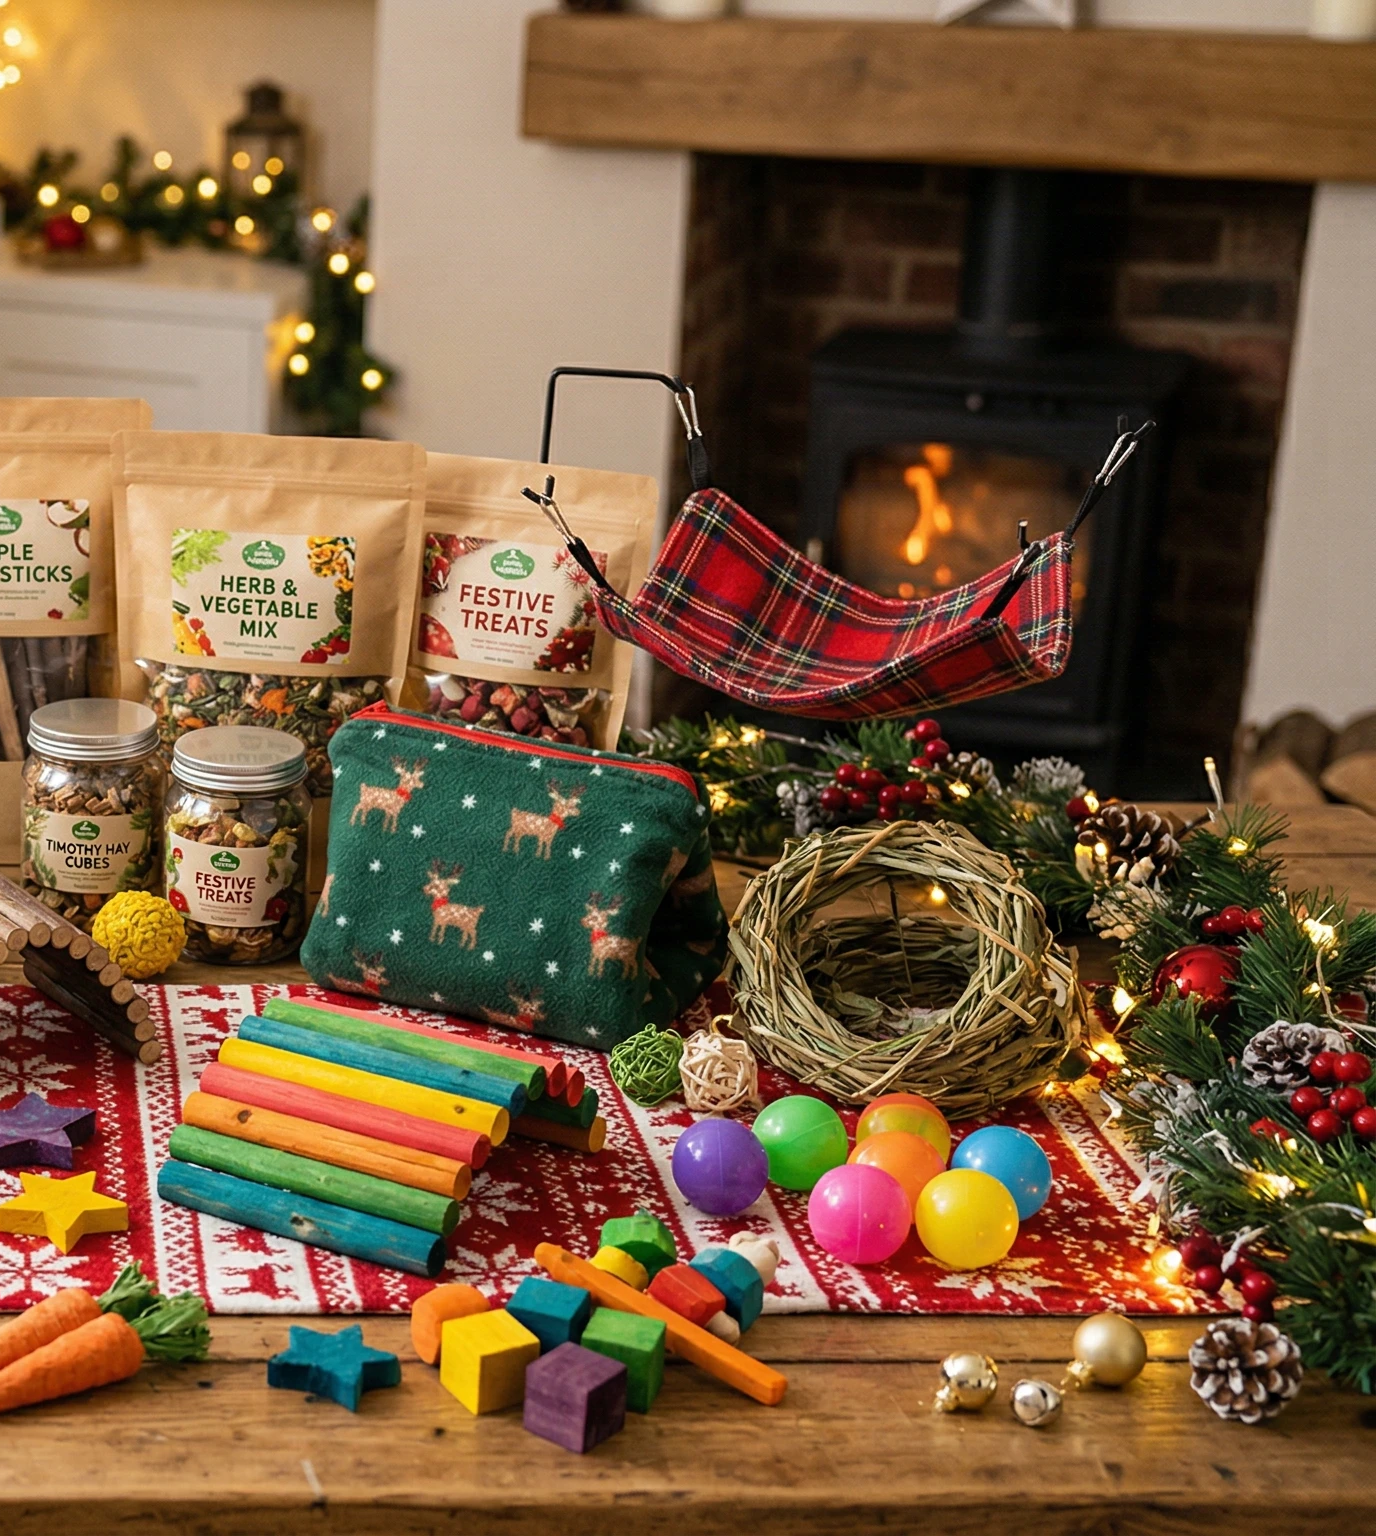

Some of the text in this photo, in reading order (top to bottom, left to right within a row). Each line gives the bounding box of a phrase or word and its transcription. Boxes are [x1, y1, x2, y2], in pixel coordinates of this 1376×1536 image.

[0, 565, 73, 583] STICKS
[220, 575, 298, 596] HERB &
[200, 595, 319, 619] VEGETABLE
[459, 584, 555, 614] FESTIVE
[239, 620, 278, 638] MIX
[460, 608, 549, 638] TREATS
[46, 838, 131, 856] TIMOTHY HAY
[65, 855, 110, 869] CUBES
[195, 871, 256, 890] FESTIVE
[197, 886, 253, 904] TREATS
